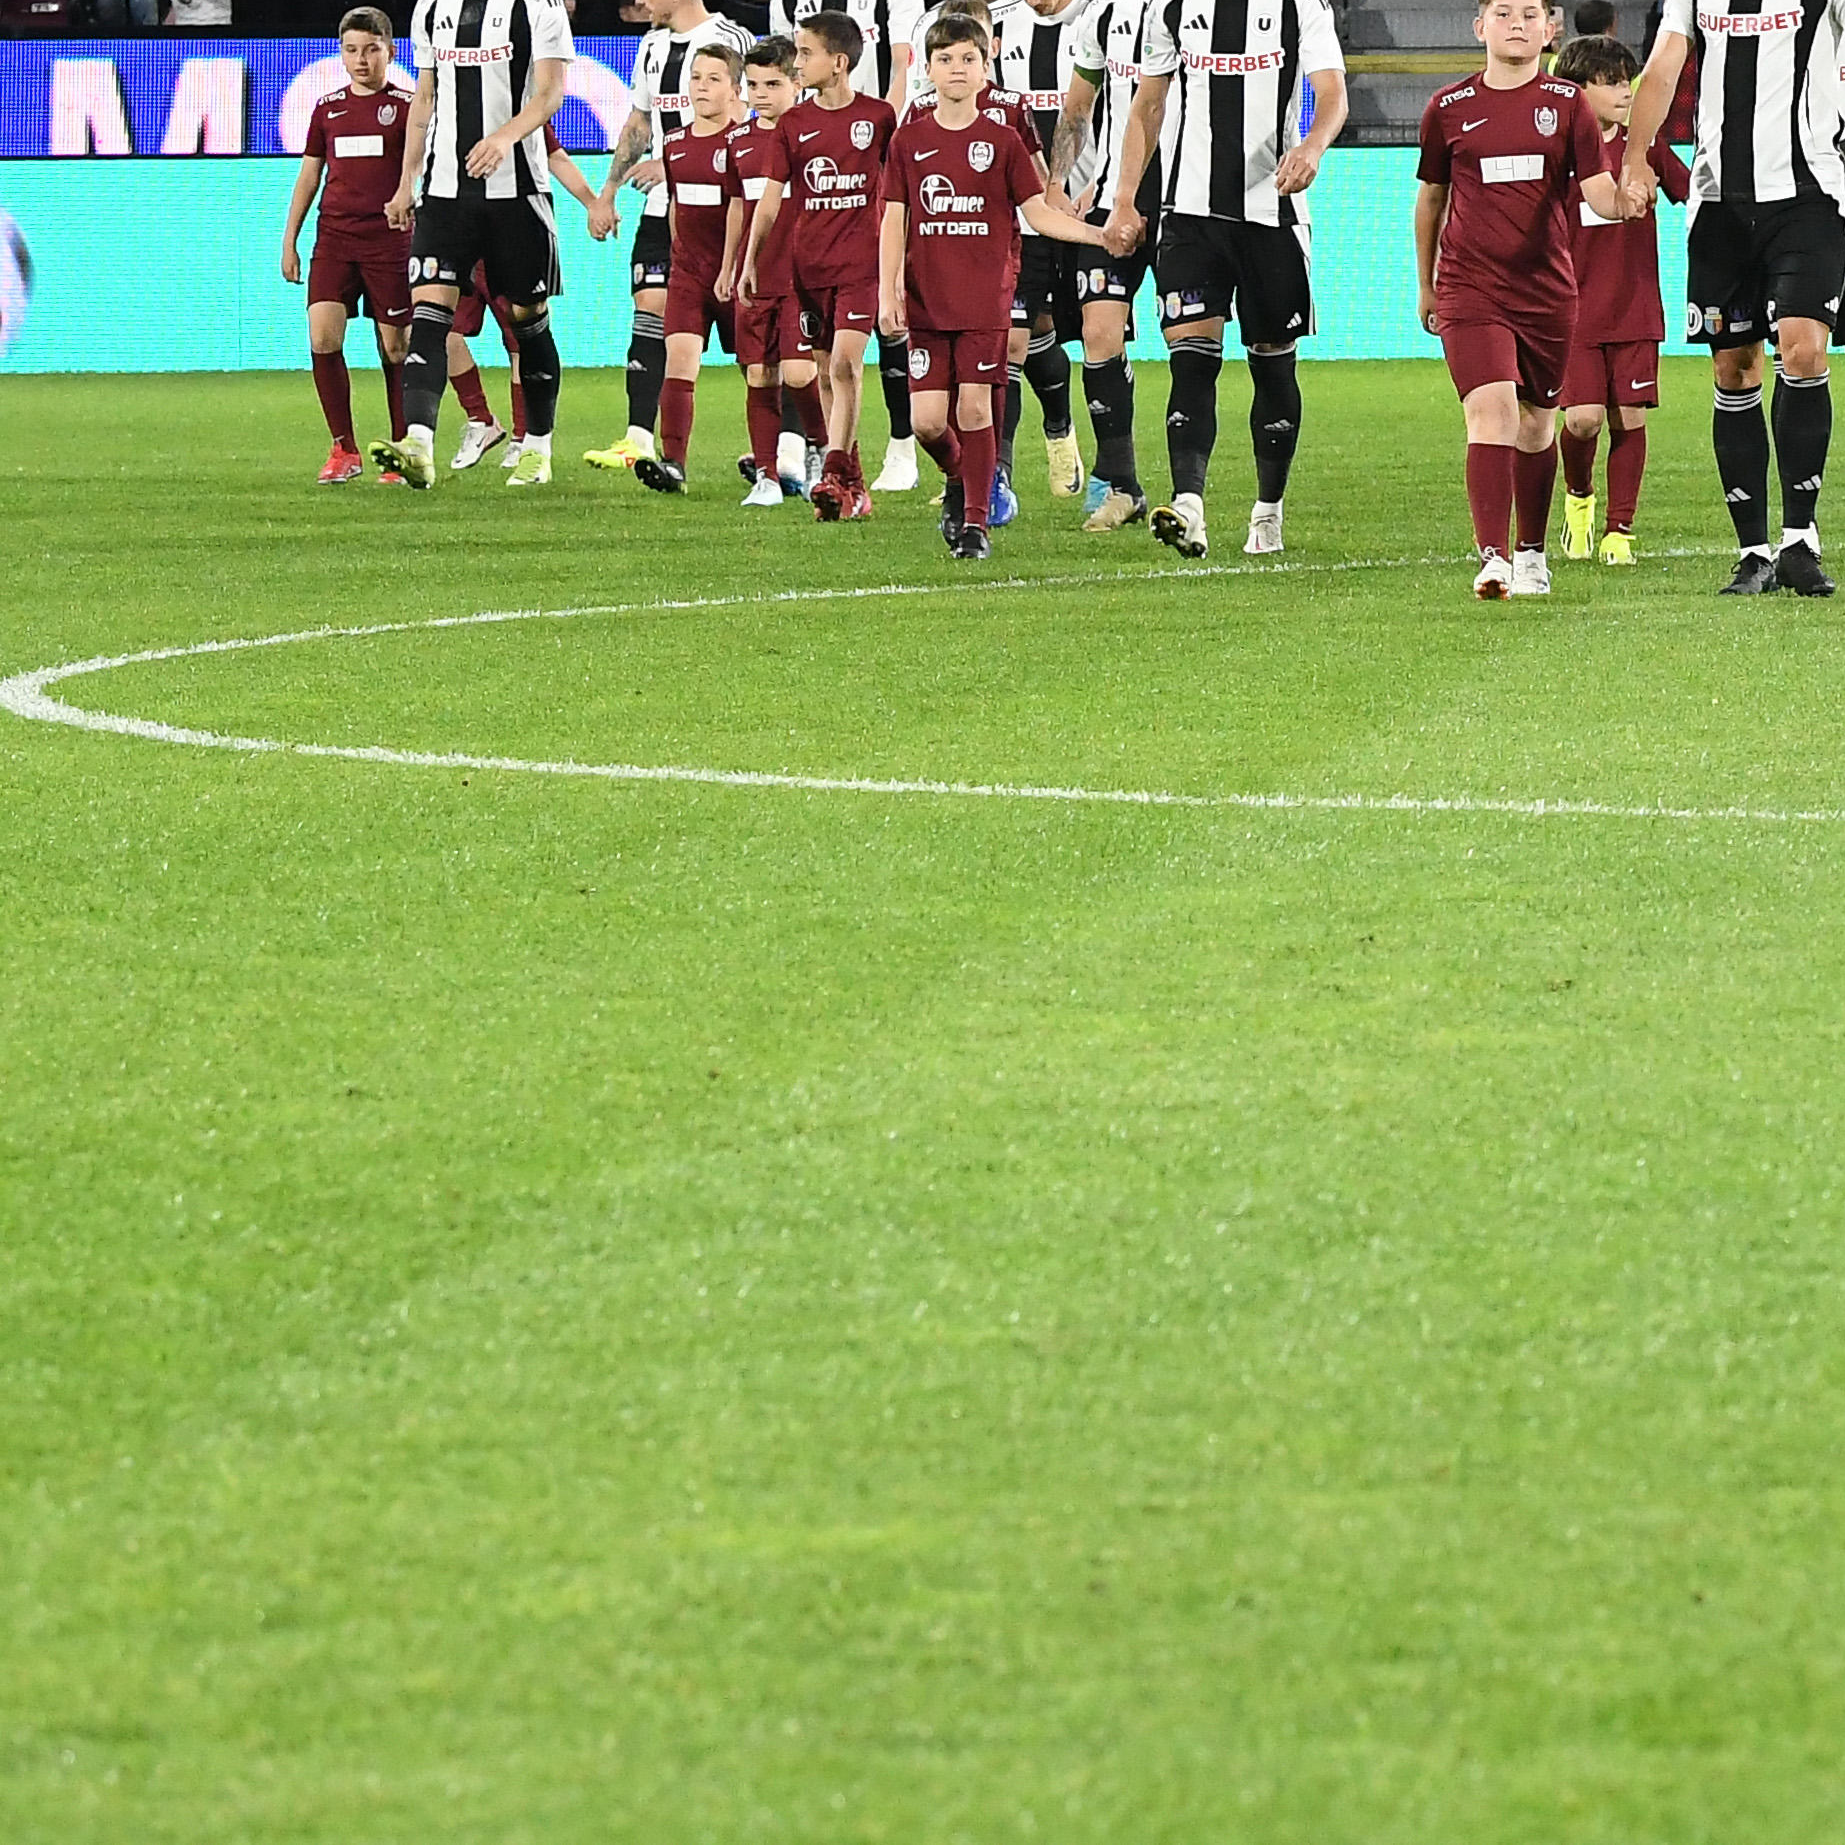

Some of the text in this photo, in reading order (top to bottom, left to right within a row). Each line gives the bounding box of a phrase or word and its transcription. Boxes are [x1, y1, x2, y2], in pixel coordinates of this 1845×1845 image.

[1257, 17, 1272, 31] U
[1698, 10, 1802, 33] SUPERBET
[1181, 50, 1284, 73] SUPERBET
[1539, 81, 1577, 100] .msg
[804, 196, 831, 212] NTT
[919, 221, 946, 236] NTT
